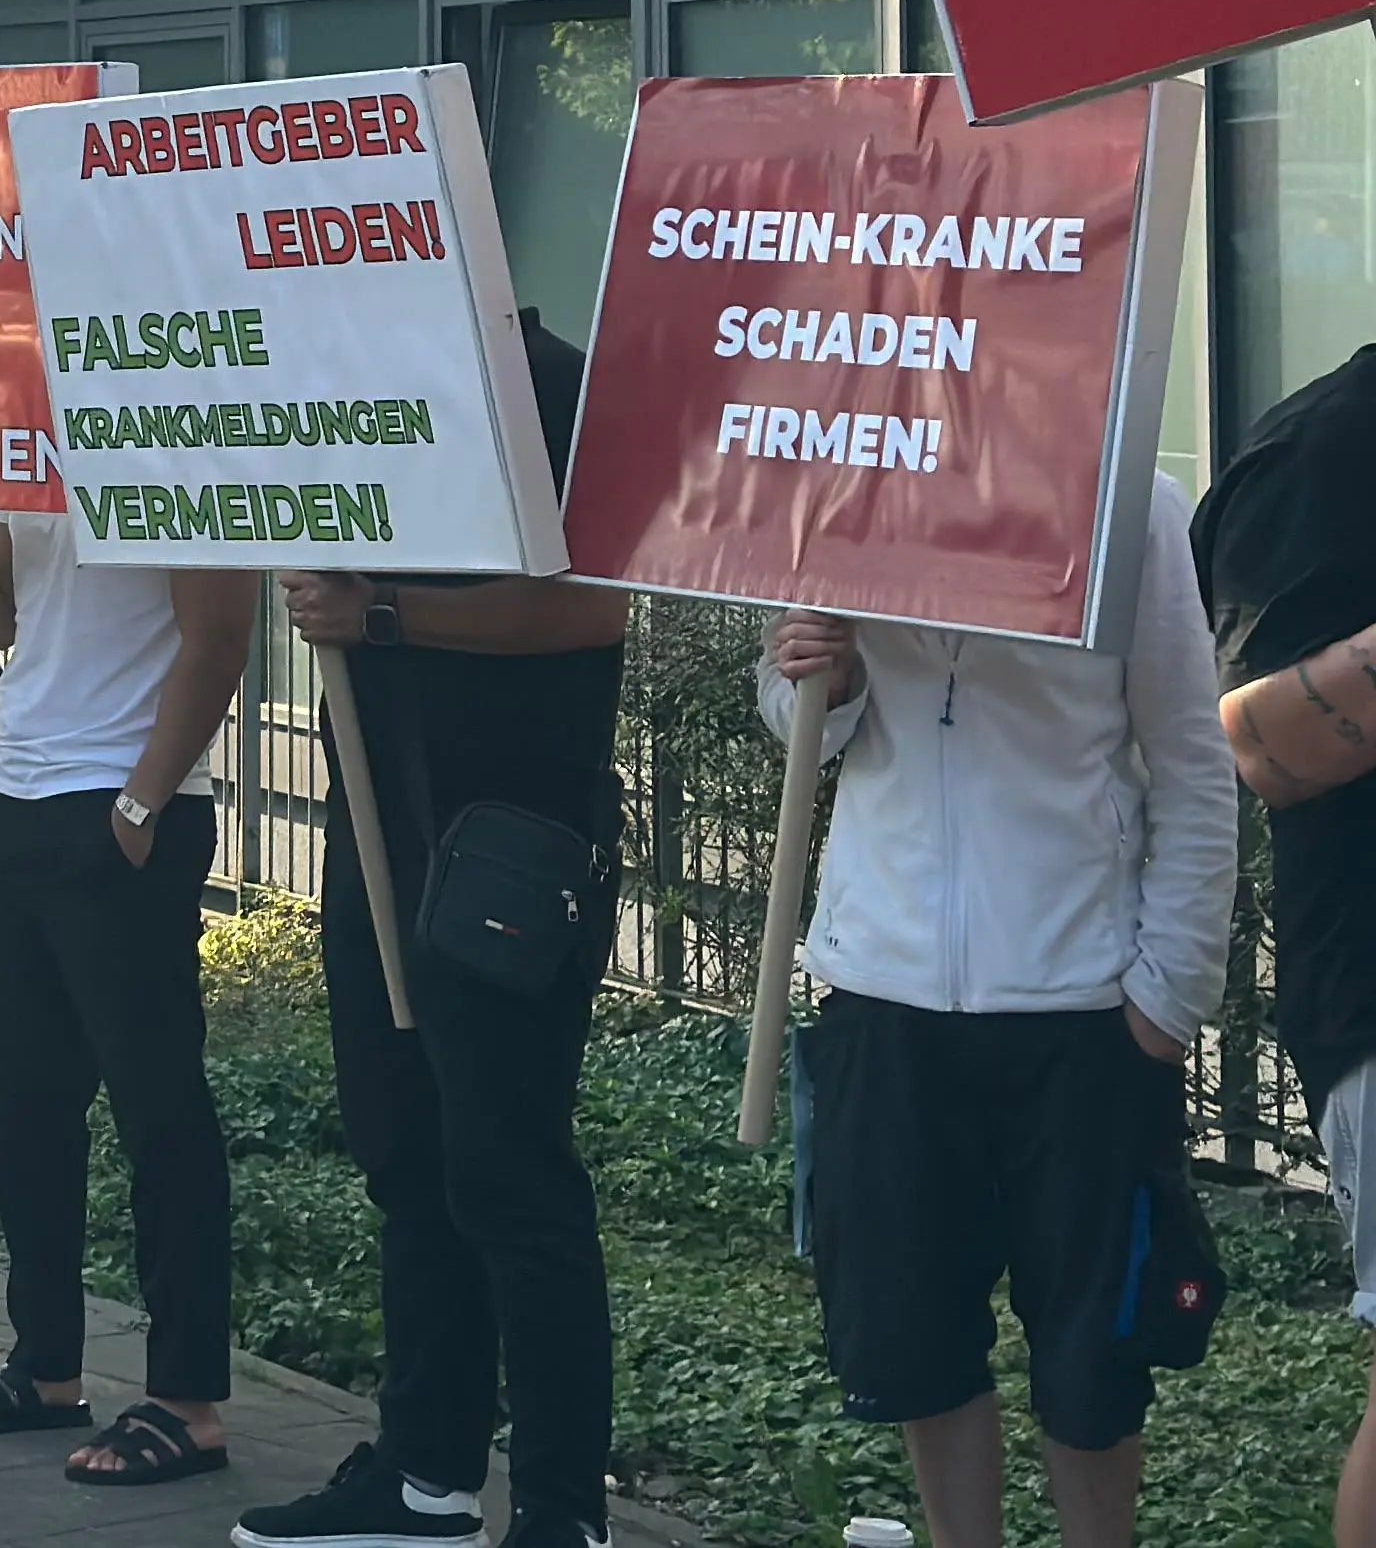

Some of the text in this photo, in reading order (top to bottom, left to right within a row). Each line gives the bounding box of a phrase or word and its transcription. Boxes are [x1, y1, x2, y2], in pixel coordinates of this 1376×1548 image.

[80, 93, 427, 179] ARBEITGEBER
[236, 200, 447, 270] LEIDEN!
[647, 207, 1085, 273] SCHEIN-KRANKE
[51, 308, 270, 372] FALSCHE
[713, 306, 977, 372] SCHADEN
[64, 399, 435, 451] KRANKMELDUNGEN
[716, 403, 943, 474] FIRMEN!
[73, 483, 394, 542] VERMEIDEN!
